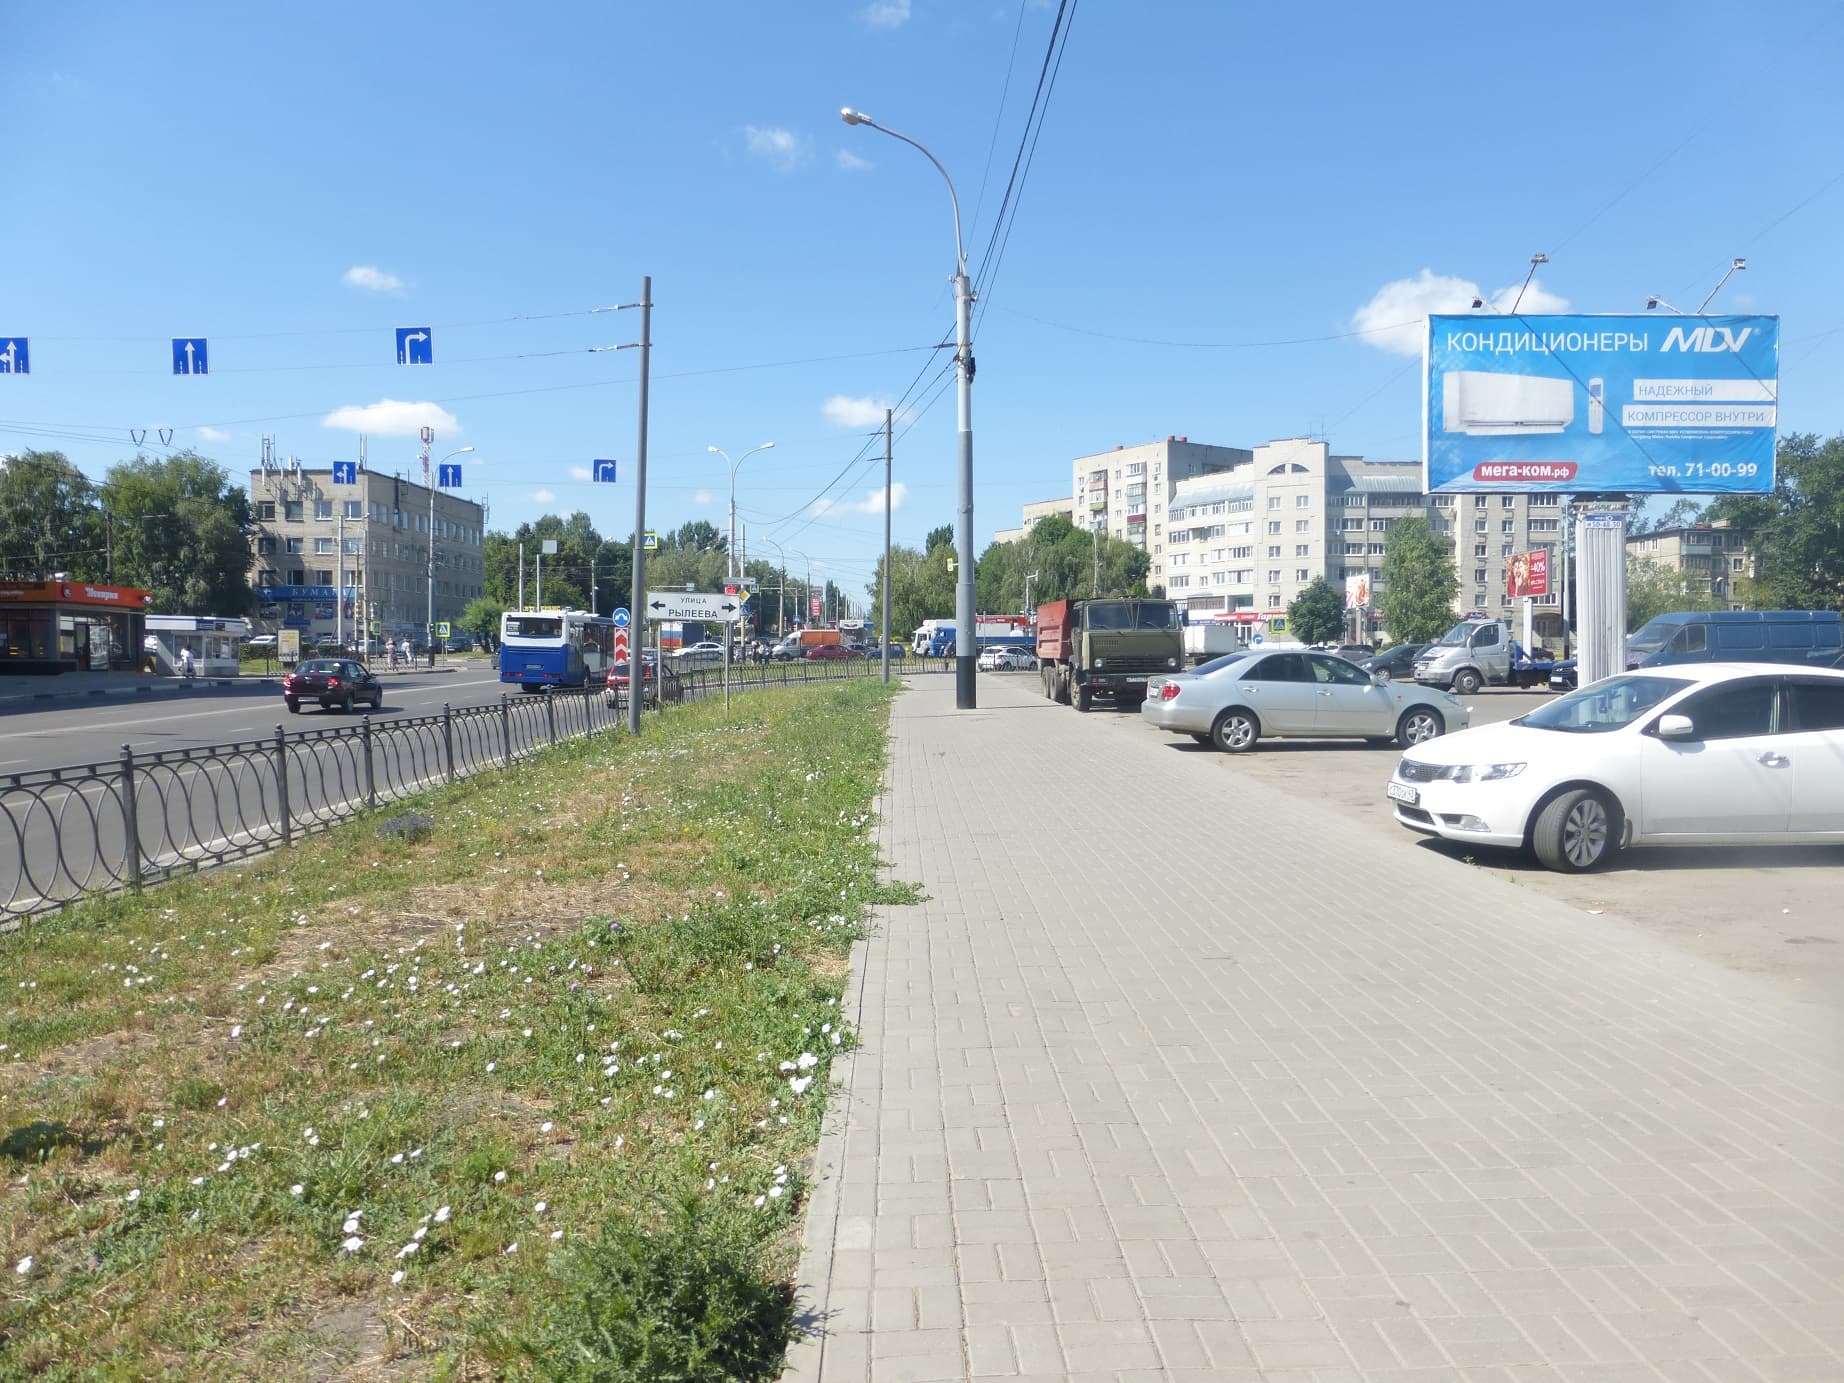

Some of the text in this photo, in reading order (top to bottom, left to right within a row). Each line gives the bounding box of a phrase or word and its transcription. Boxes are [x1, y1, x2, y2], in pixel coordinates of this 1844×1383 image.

[1447, 331, 1648, 356] КОНДИЦИОНЕРЫ
[1639, 384, 1713, 398] НАДЕЖНЫЙ
[1627, 411, 1765, 423] КОМПРЕССОР ВНУТРИ
[1481, 465, 1570, 478] мега-ком.рф
[1648, 462, 1758, 477] тел. 71-00-99
[680, 597, 707, 605] УЛИЦА
[668, 608, 718, 619] РЫЛЕЕВА
